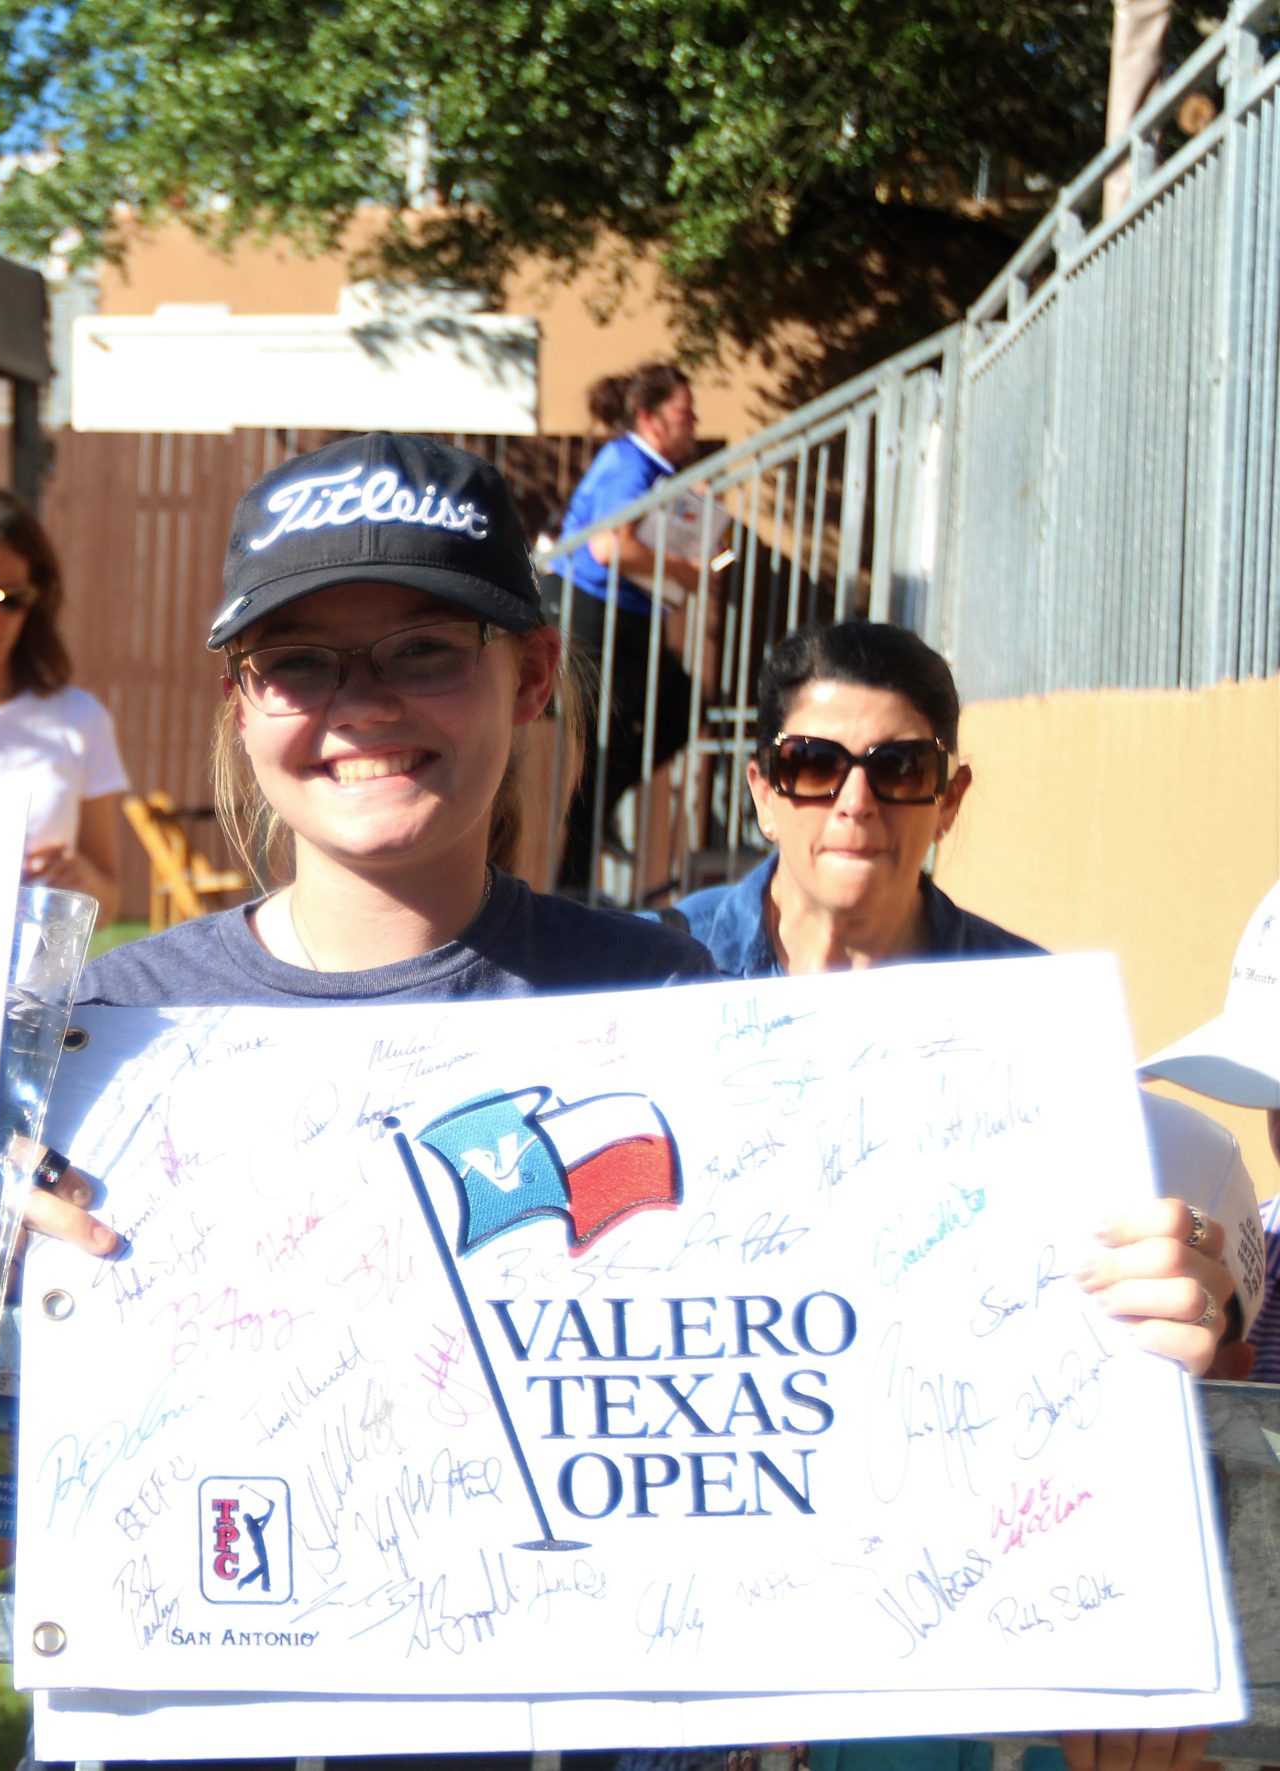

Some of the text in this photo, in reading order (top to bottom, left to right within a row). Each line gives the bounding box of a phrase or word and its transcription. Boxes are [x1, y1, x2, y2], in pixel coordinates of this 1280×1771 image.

[249, 465, 489, 552] Titleist
[485, 1289, 858, 1362] VALERO
[526, 1369, 835, 1439] TEXAS
[557, 1448, 818, 1520] OPEN
[211, 1498, 241, 1581] TPC
[171, 1626, 320, 1647] SAN ANTONIO
